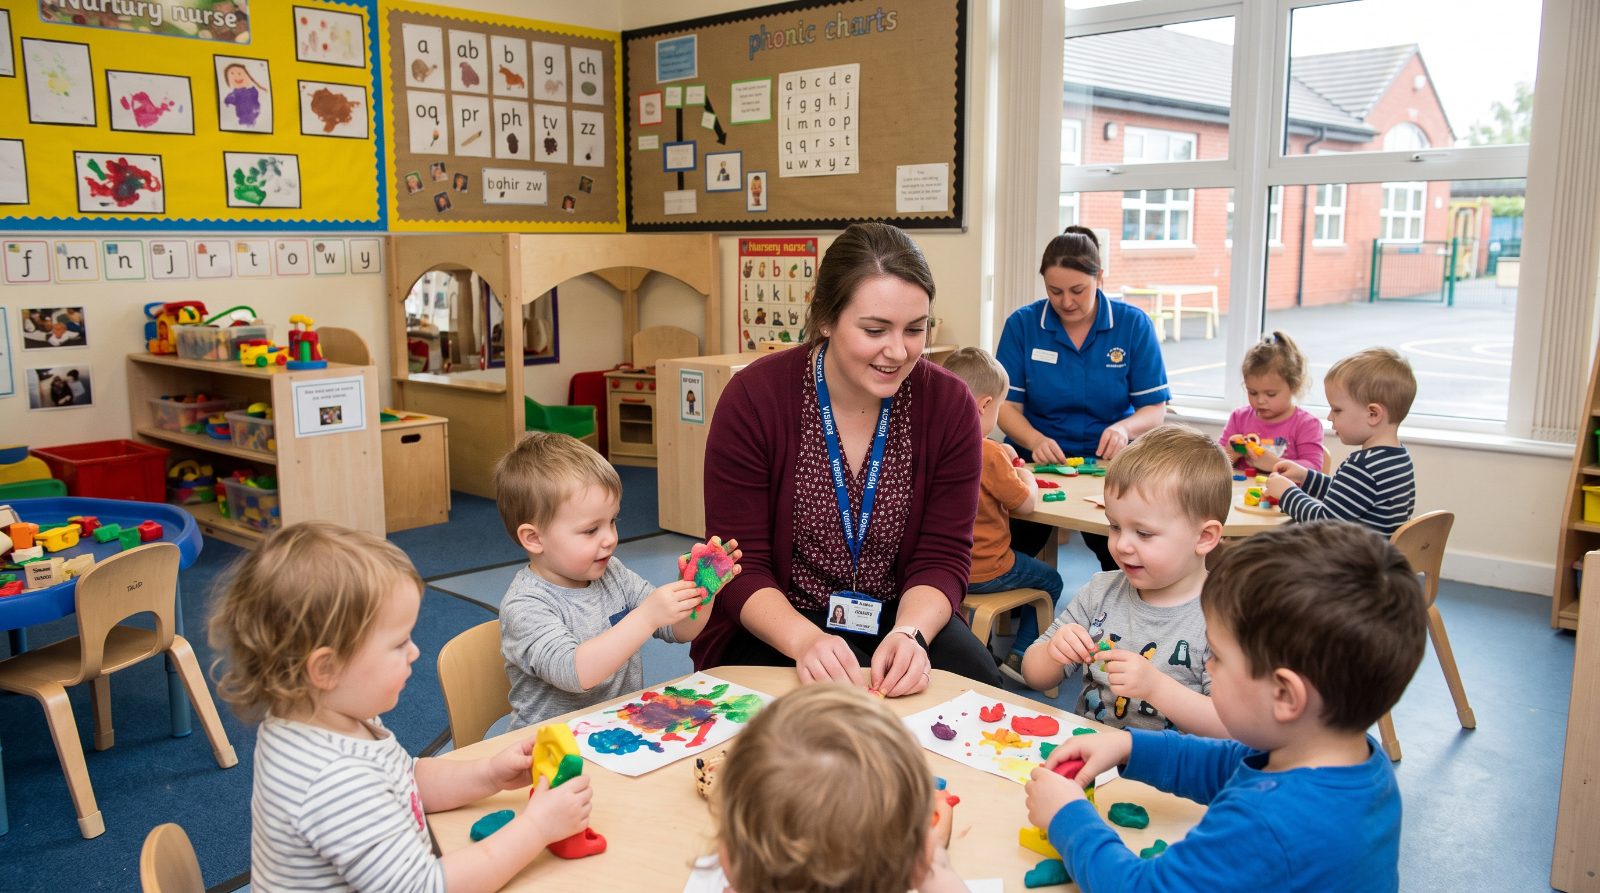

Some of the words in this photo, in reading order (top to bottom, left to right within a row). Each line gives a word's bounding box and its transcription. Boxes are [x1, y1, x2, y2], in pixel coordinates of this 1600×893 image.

[172, 5, 238, 28] nurse
[748, 19, 817, 61] phonic
[825, 7, 898, 40] charts
[417, 39, 430, 55] a
[457, 40, 480, 60] ab
[504, 45, 514, 64] b
[544, 56, 554, 75] g
[578, 57, 596, 75] ch
[786, 82, 792, 90] a
[800, 76, 806, 89] b
[814, 78, 820, 87] c
[830, 72, 836, 85] d
[844, 74, 851, 83] e
[786, 96, 791, 110] f
[800, 100, 806, 113] g
[814, 98, 820, 112] g
[830, 94, 836, 106] h
[844, 92, 849, 109] j
[461, 108, 480, 129] pr
[501, 108, 523, 132] ph
[542, 113, 558, 130] tv
[798, 120, 808, 129] m
[814, 118, 821, 128] n
[828, 118, 835, 126] o
[844, 116, 850, 129] p
[580, 122, 596, 136] zz
[785, 142, 792, 154] q
[799, 140, 806, 152] q
[816, 138, 820, 148] r
[830, 138, 835, 147] s
[846, 134, 850, 146] t
[786, 160, 792, 169] u
[798, 160, 808, 168] w
[814, 160, 821, 168] x
[830, 158, 835, 171] y
[844, 156, 850, 166] z
[21, 249, 33, 278] f
[66, 255, 89, 270] m
[118, 255, 132, 269] n
[166, 249, 174, 274] j
[209, 253, 217, 267] r
[249, 251, 258, 267] t
[287, 252, 298, 266] o
[323, 252, 336, 265] w
[360, 251, 371, 270] y
